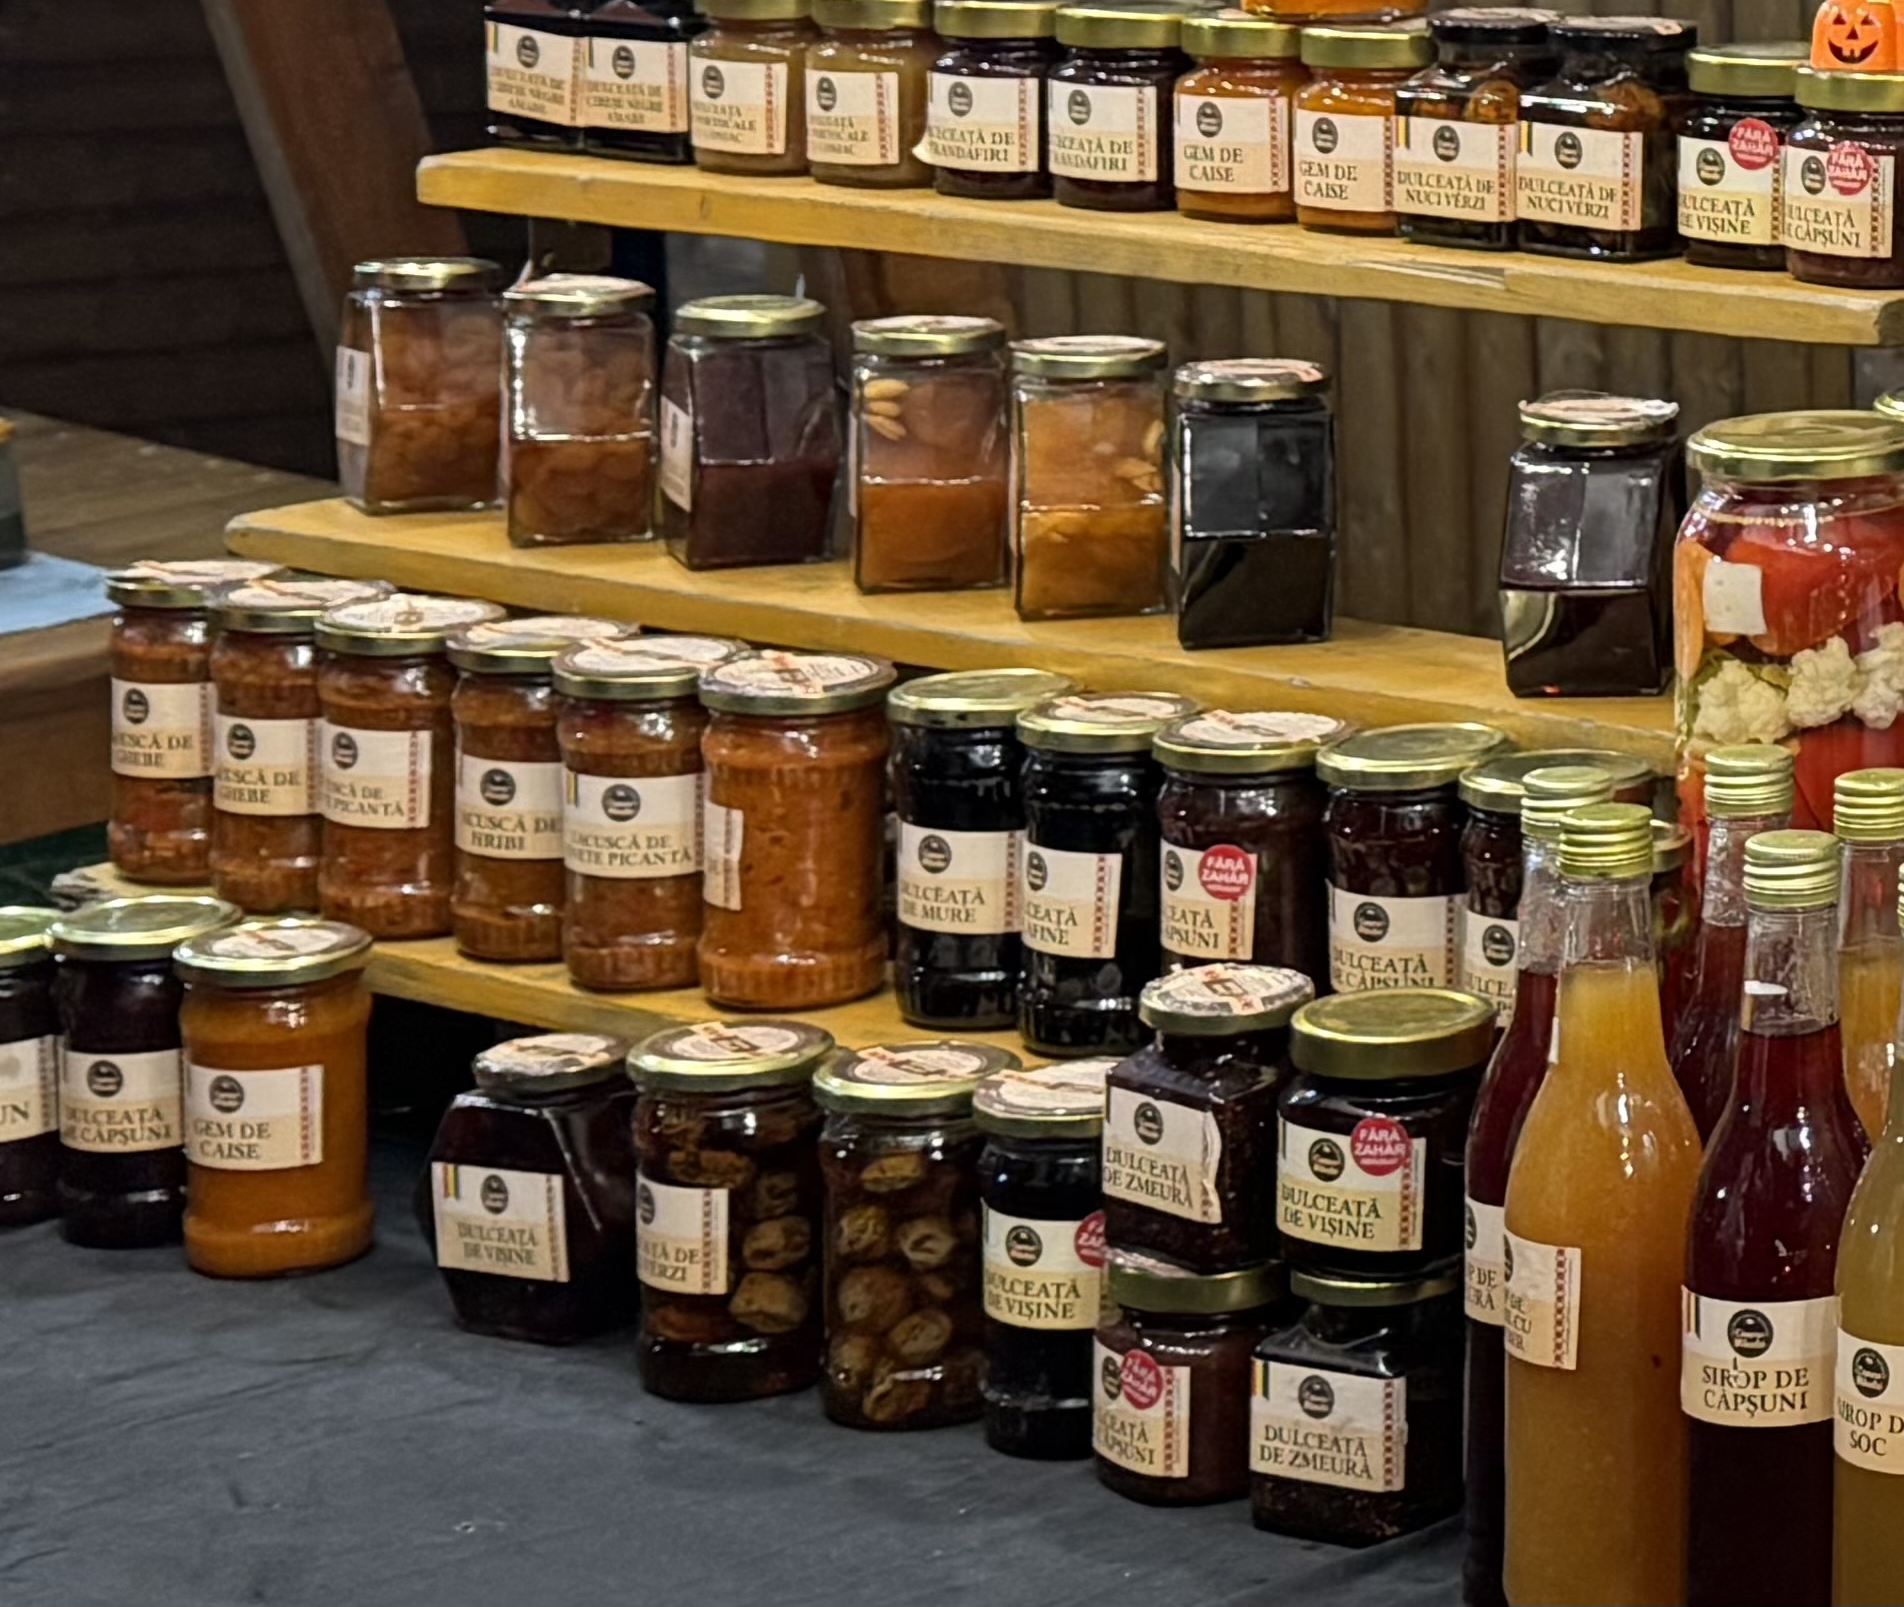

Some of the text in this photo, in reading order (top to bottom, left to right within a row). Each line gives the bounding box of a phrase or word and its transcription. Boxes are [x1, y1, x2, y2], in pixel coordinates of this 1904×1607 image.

[990, 132, 1015, 146] DE
[1110, 139, 1133, 154] DE
[1183, 144, 1244, 163] GEM DE
[1189, 165, 1236, 183] CAISE
[1299, 160, 1358, 182] GEM DE
[1397, 168, 1496, 194] DULCEAȚĂ DE
[1303, 180, 1349, 200] CAISE
[1518, 174, 1619, 202] DULCEAȚĂ DE
[1404, 188, 1486, 211] NUCI VERZI
[1526, 197, 1610, 220] NUCI VERZI
[1696, 214, 1752, 236] VIȘINE
[1786, 206, 1855, 230] ULCEAȚĂ
[1795, 225, 1862, 248] CĂPȘUNI
[168, 735, 193, 751] DE
[274, 770, 303, 787] DE
[361, 785, 383, 800] DE
[533, 815, 562, 834] DE
[470, 832, 526, 851] HRIBI
[644, 832, 671, 849] DE
[607, 846, 693, 867] PICANTĂ
[1206, 855, 1246, 871] FĂRĂ
[921, 902, 977, 924] MURE
[1024, 901, 1079, 928] CEAȚĂ
[80, 1125, 172, 1146] CĂPȘUNI
[193, 1118, 272, 1140] GEM DE
[1358, 1126, 1401, 1143] FĂRĂ
[200, 1143, 264, 1160] CAISE
[1354, 1140, 1406, 1157] ZAHĂR
[1105, 1145, 1189, 1185] DULCEAȚĂ
[1102, 1166, 1194, 1210] DE ZMEURĂ
[1281, 1182, 1383, 1221] DULCEAȚĂ
[1282, 1203, 1377, 1241] DE VIȘINE
[457, 1221, 538, 1249] DULCEAȚĂ
[463, 1242, 538, 1268] DE VIȘINE
[674, 1246, 700, 1265] DE
[645, 1260, 687, 1282] ERZI
[1476, 1267, 1498, 1289] DE
[1005, 1296, 1076, 1323] VIȘINE
[1702, 1364, 1810, 1390] SIROP DE
[1703, 1390, 1808, 1418] CĂPȘUNI
[1264, 1423, 1368, 1459] DULCEAȚĂ
[1849, 1430, 1887, 1457] SOC
[1260, 1445, 1373, 1479] DE ZMEURĂ
